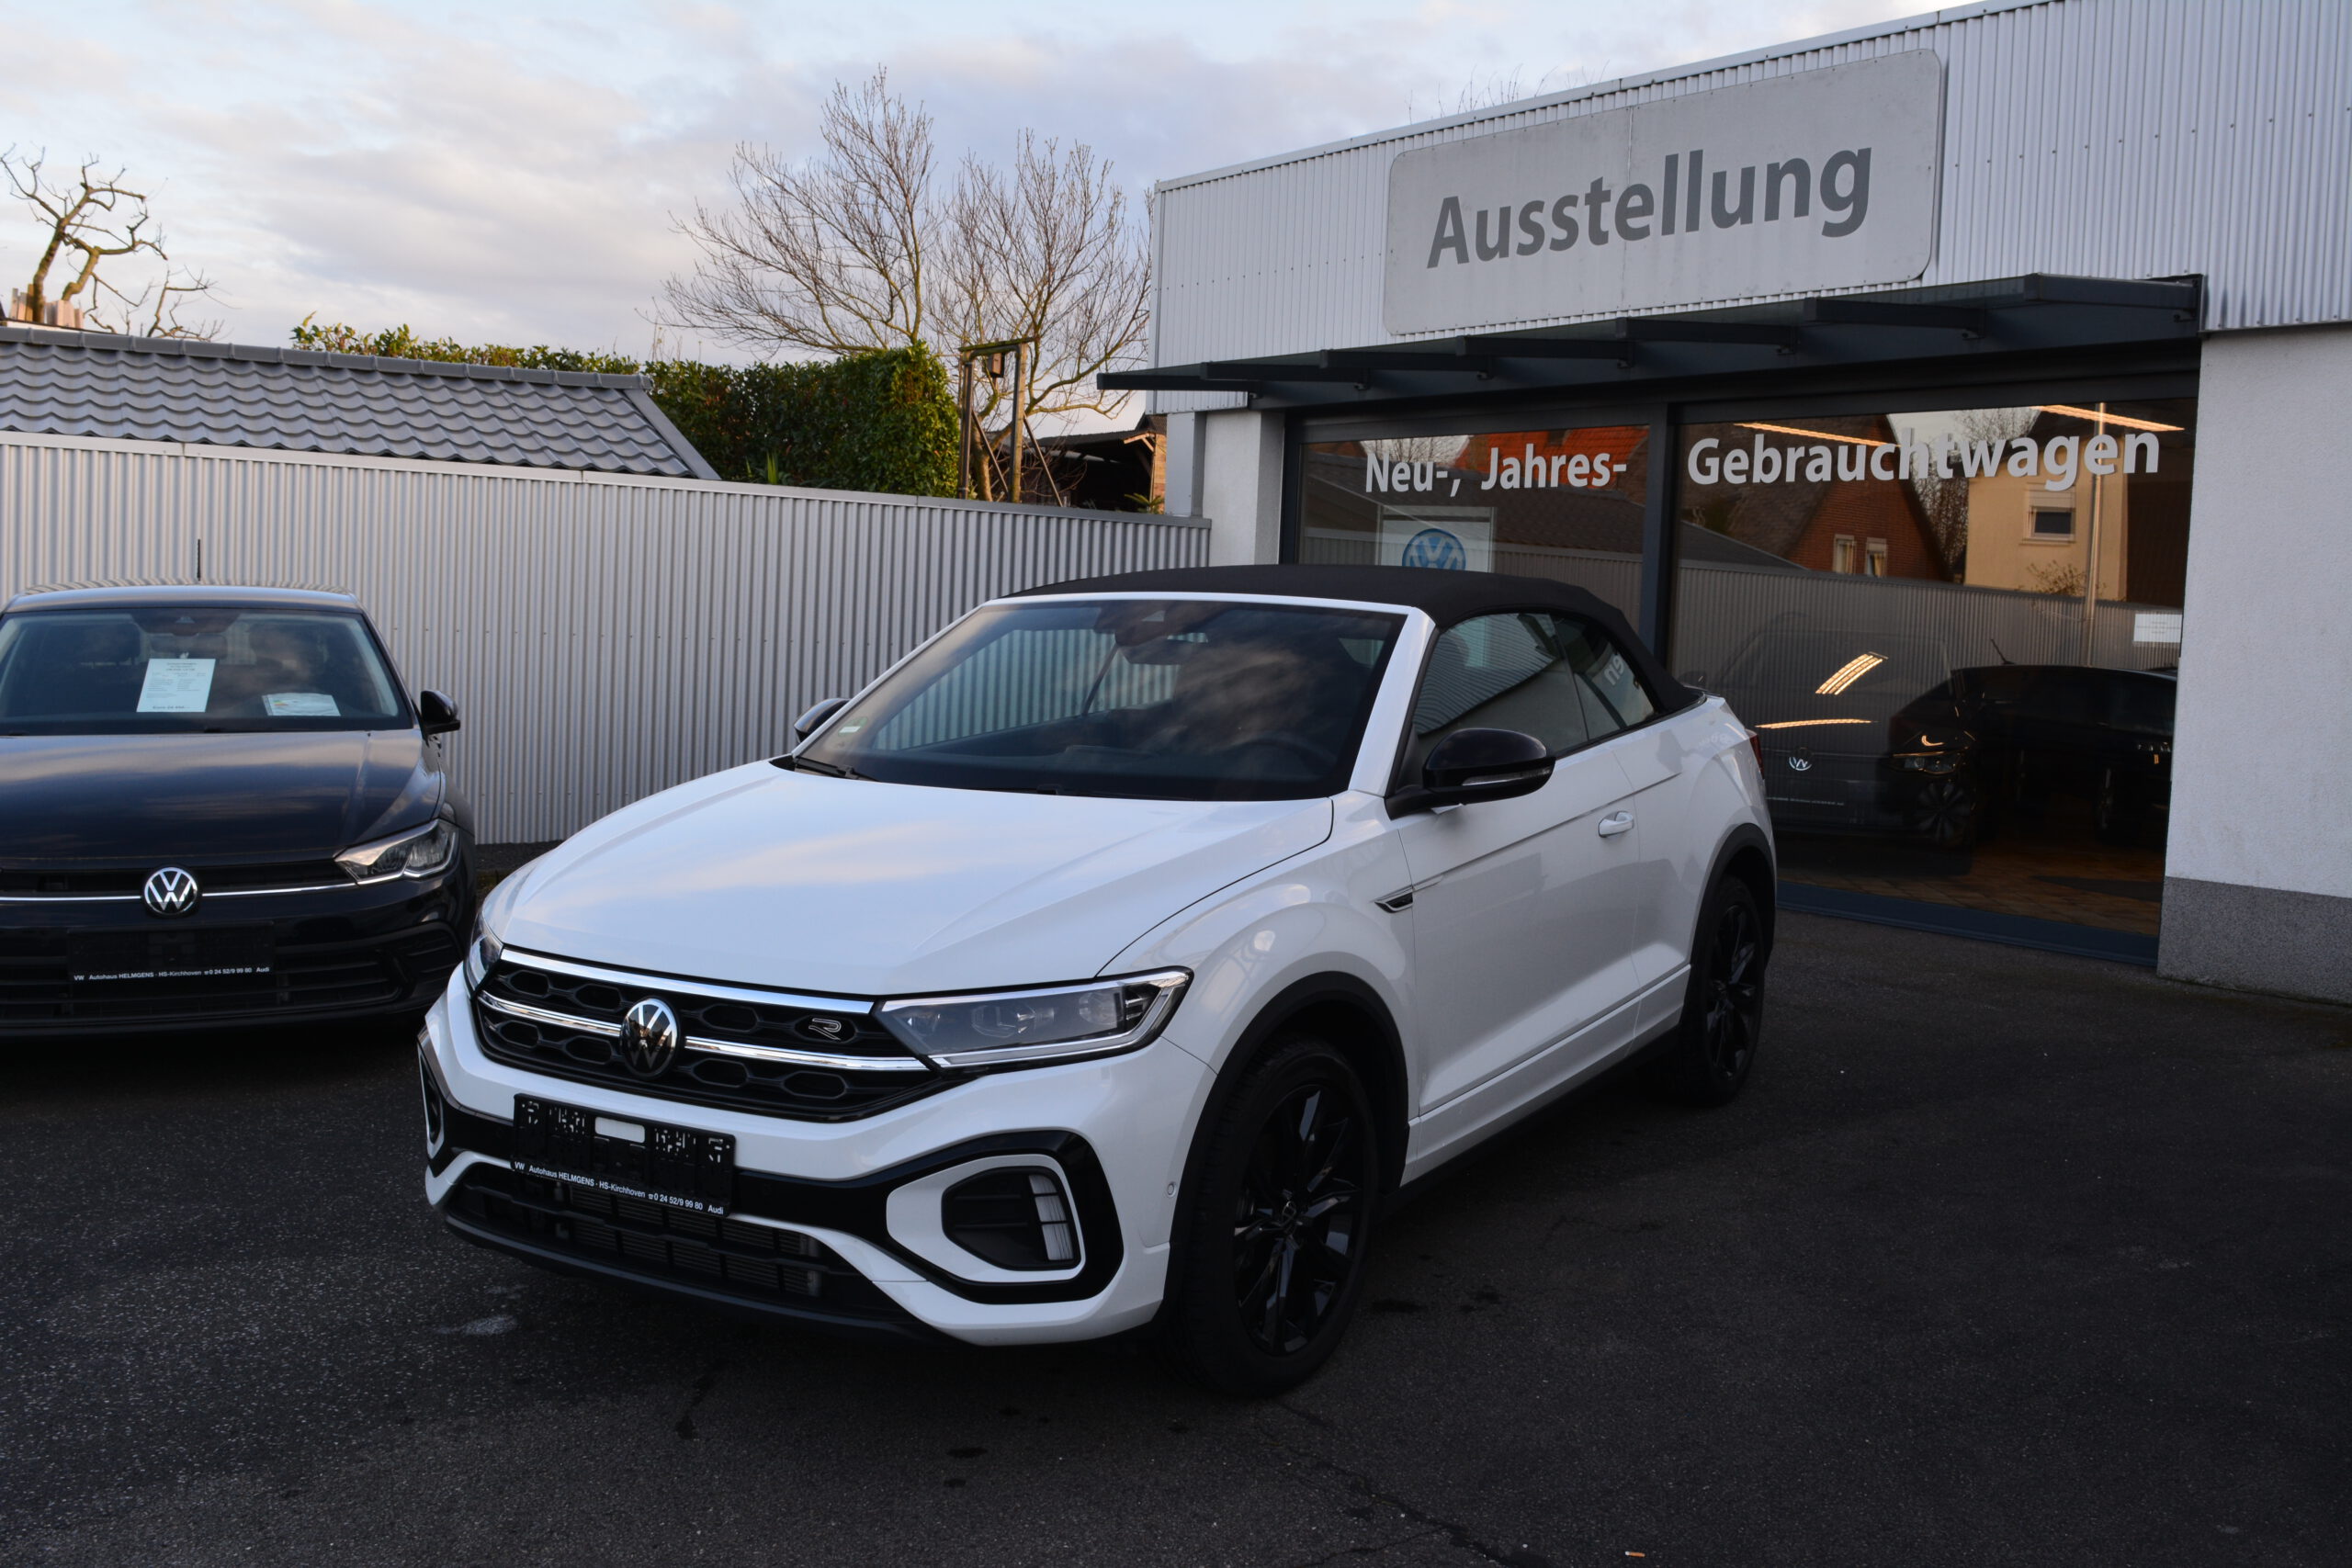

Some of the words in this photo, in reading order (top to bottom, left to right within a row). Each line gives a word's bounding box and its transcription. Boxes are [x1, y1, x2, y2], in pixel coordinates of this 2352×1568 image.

[1427, 147, 1872, 269] Ausstellung
[1365, 452, 1461, 497] Neu-,
[1481, 443, 1627, 491] Jahres-
[1687, 427, 2160, 491] Gebrauchtwagen
[514, 1161, 526, 1170] VW
[528, 1165, 558, 1179] Autohaus
[559, 1171, 595, 1187] HELMGENS
[599, 1180, 646, 1198] HS-Kirchhoven
[660, 1194, 668, 1202] 24
[669, 1196, 684, 1206] 52/9
[684, 1199, 694, 1208] 99
[695, 1201, 703, 1211] 80
[707, 1204, 724, 1215] Audi
